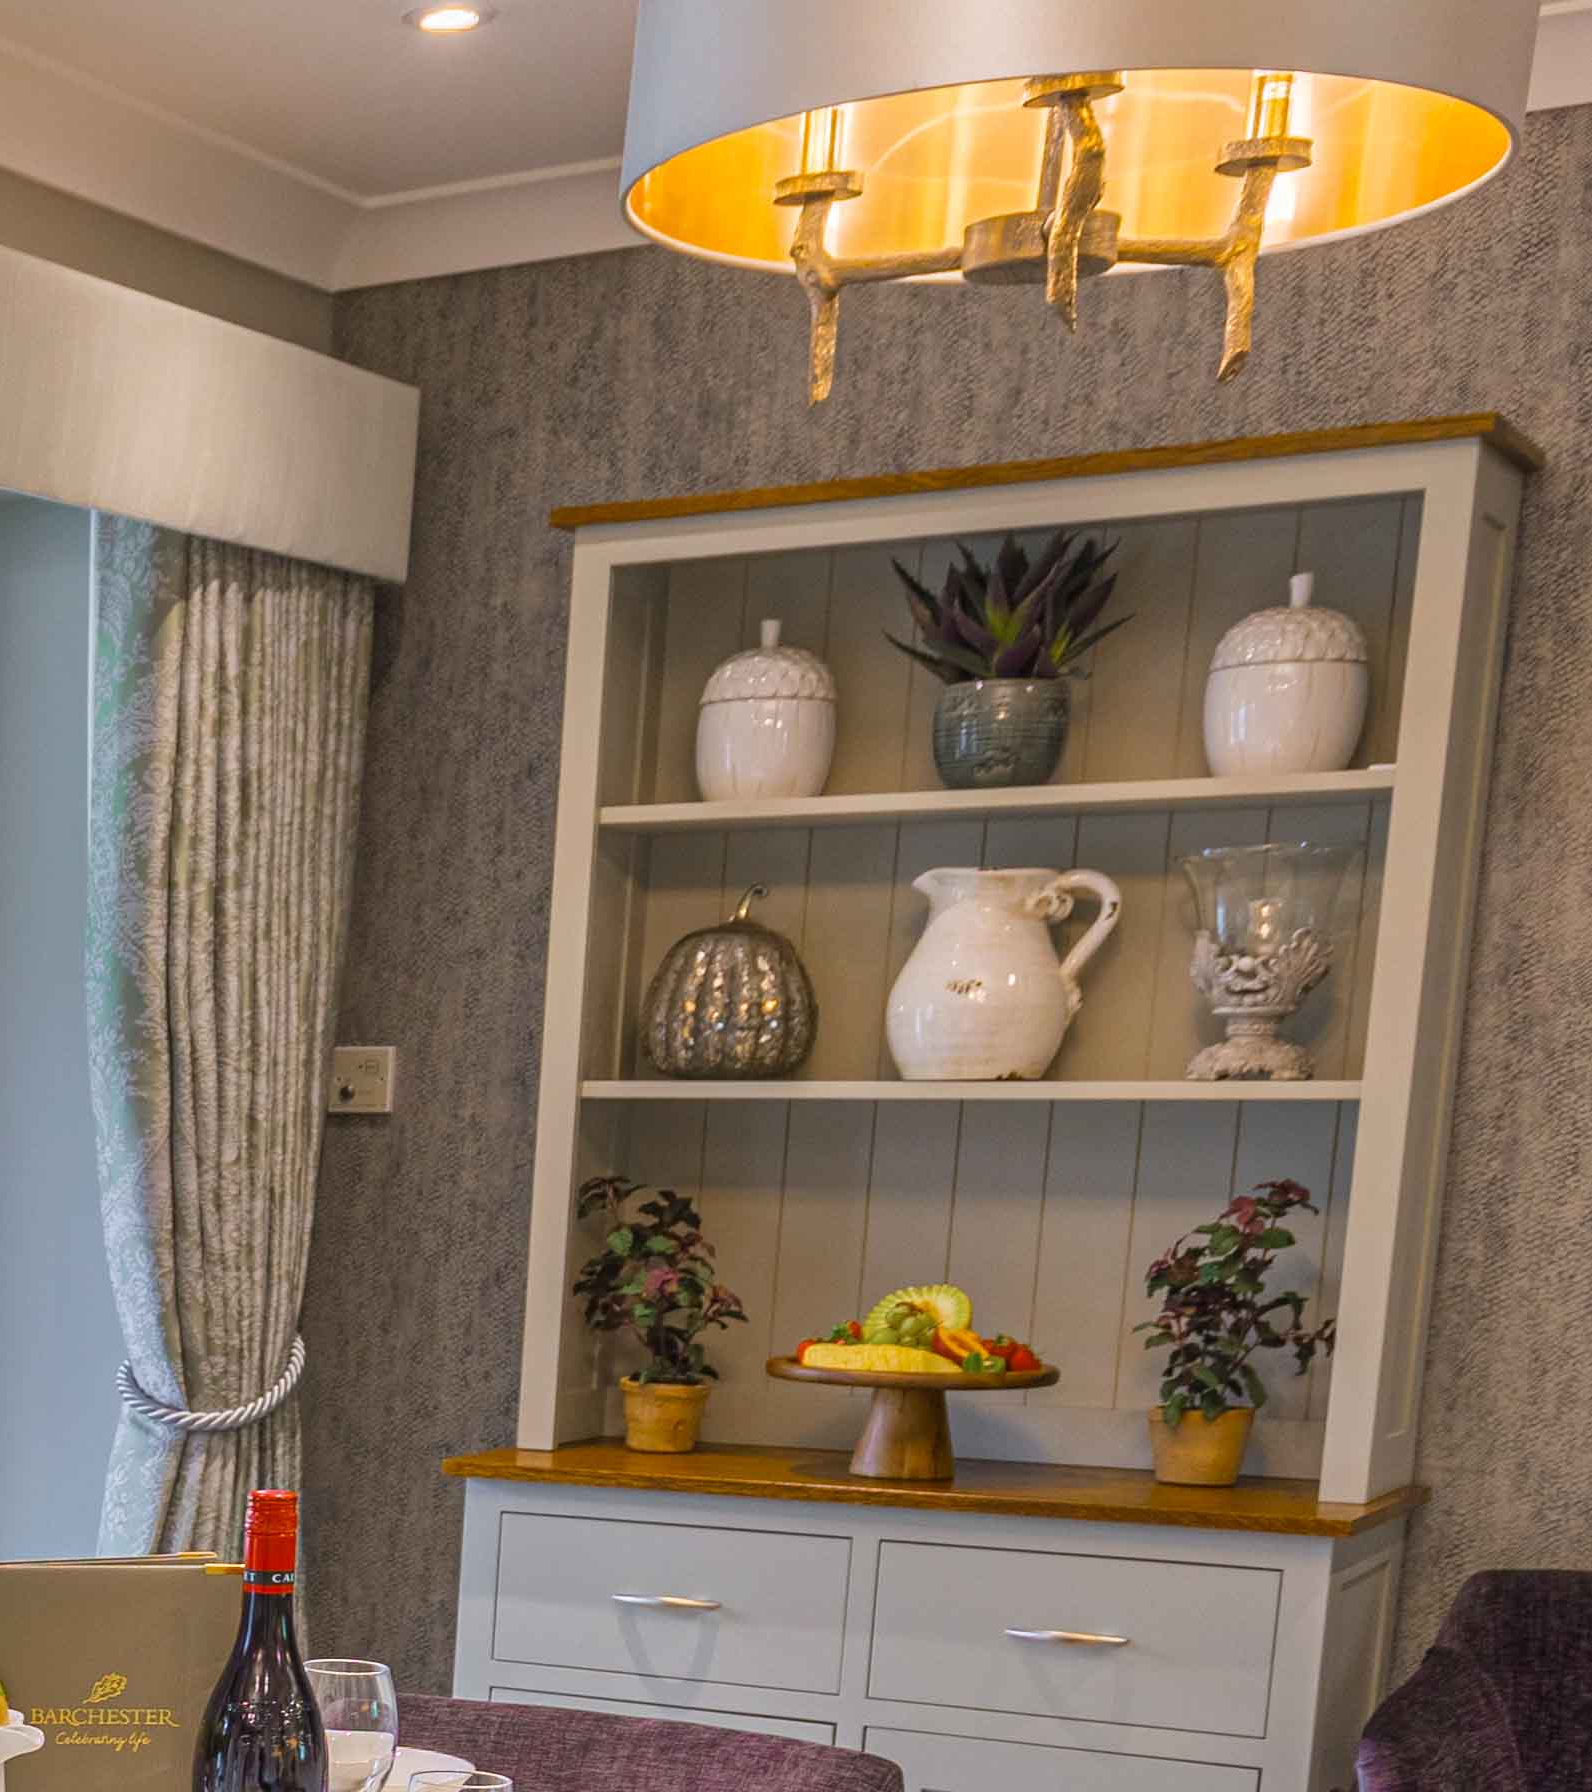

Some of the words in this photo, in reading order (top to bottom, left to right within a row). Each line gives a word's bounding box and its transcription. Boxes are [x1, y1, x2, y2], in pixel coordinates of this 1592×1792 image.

[29, 1707, 182, 1728] BARCHESTER
[55, 1730, 127, 1753] Celebrating
[128, 1729, 152, 1753] life
